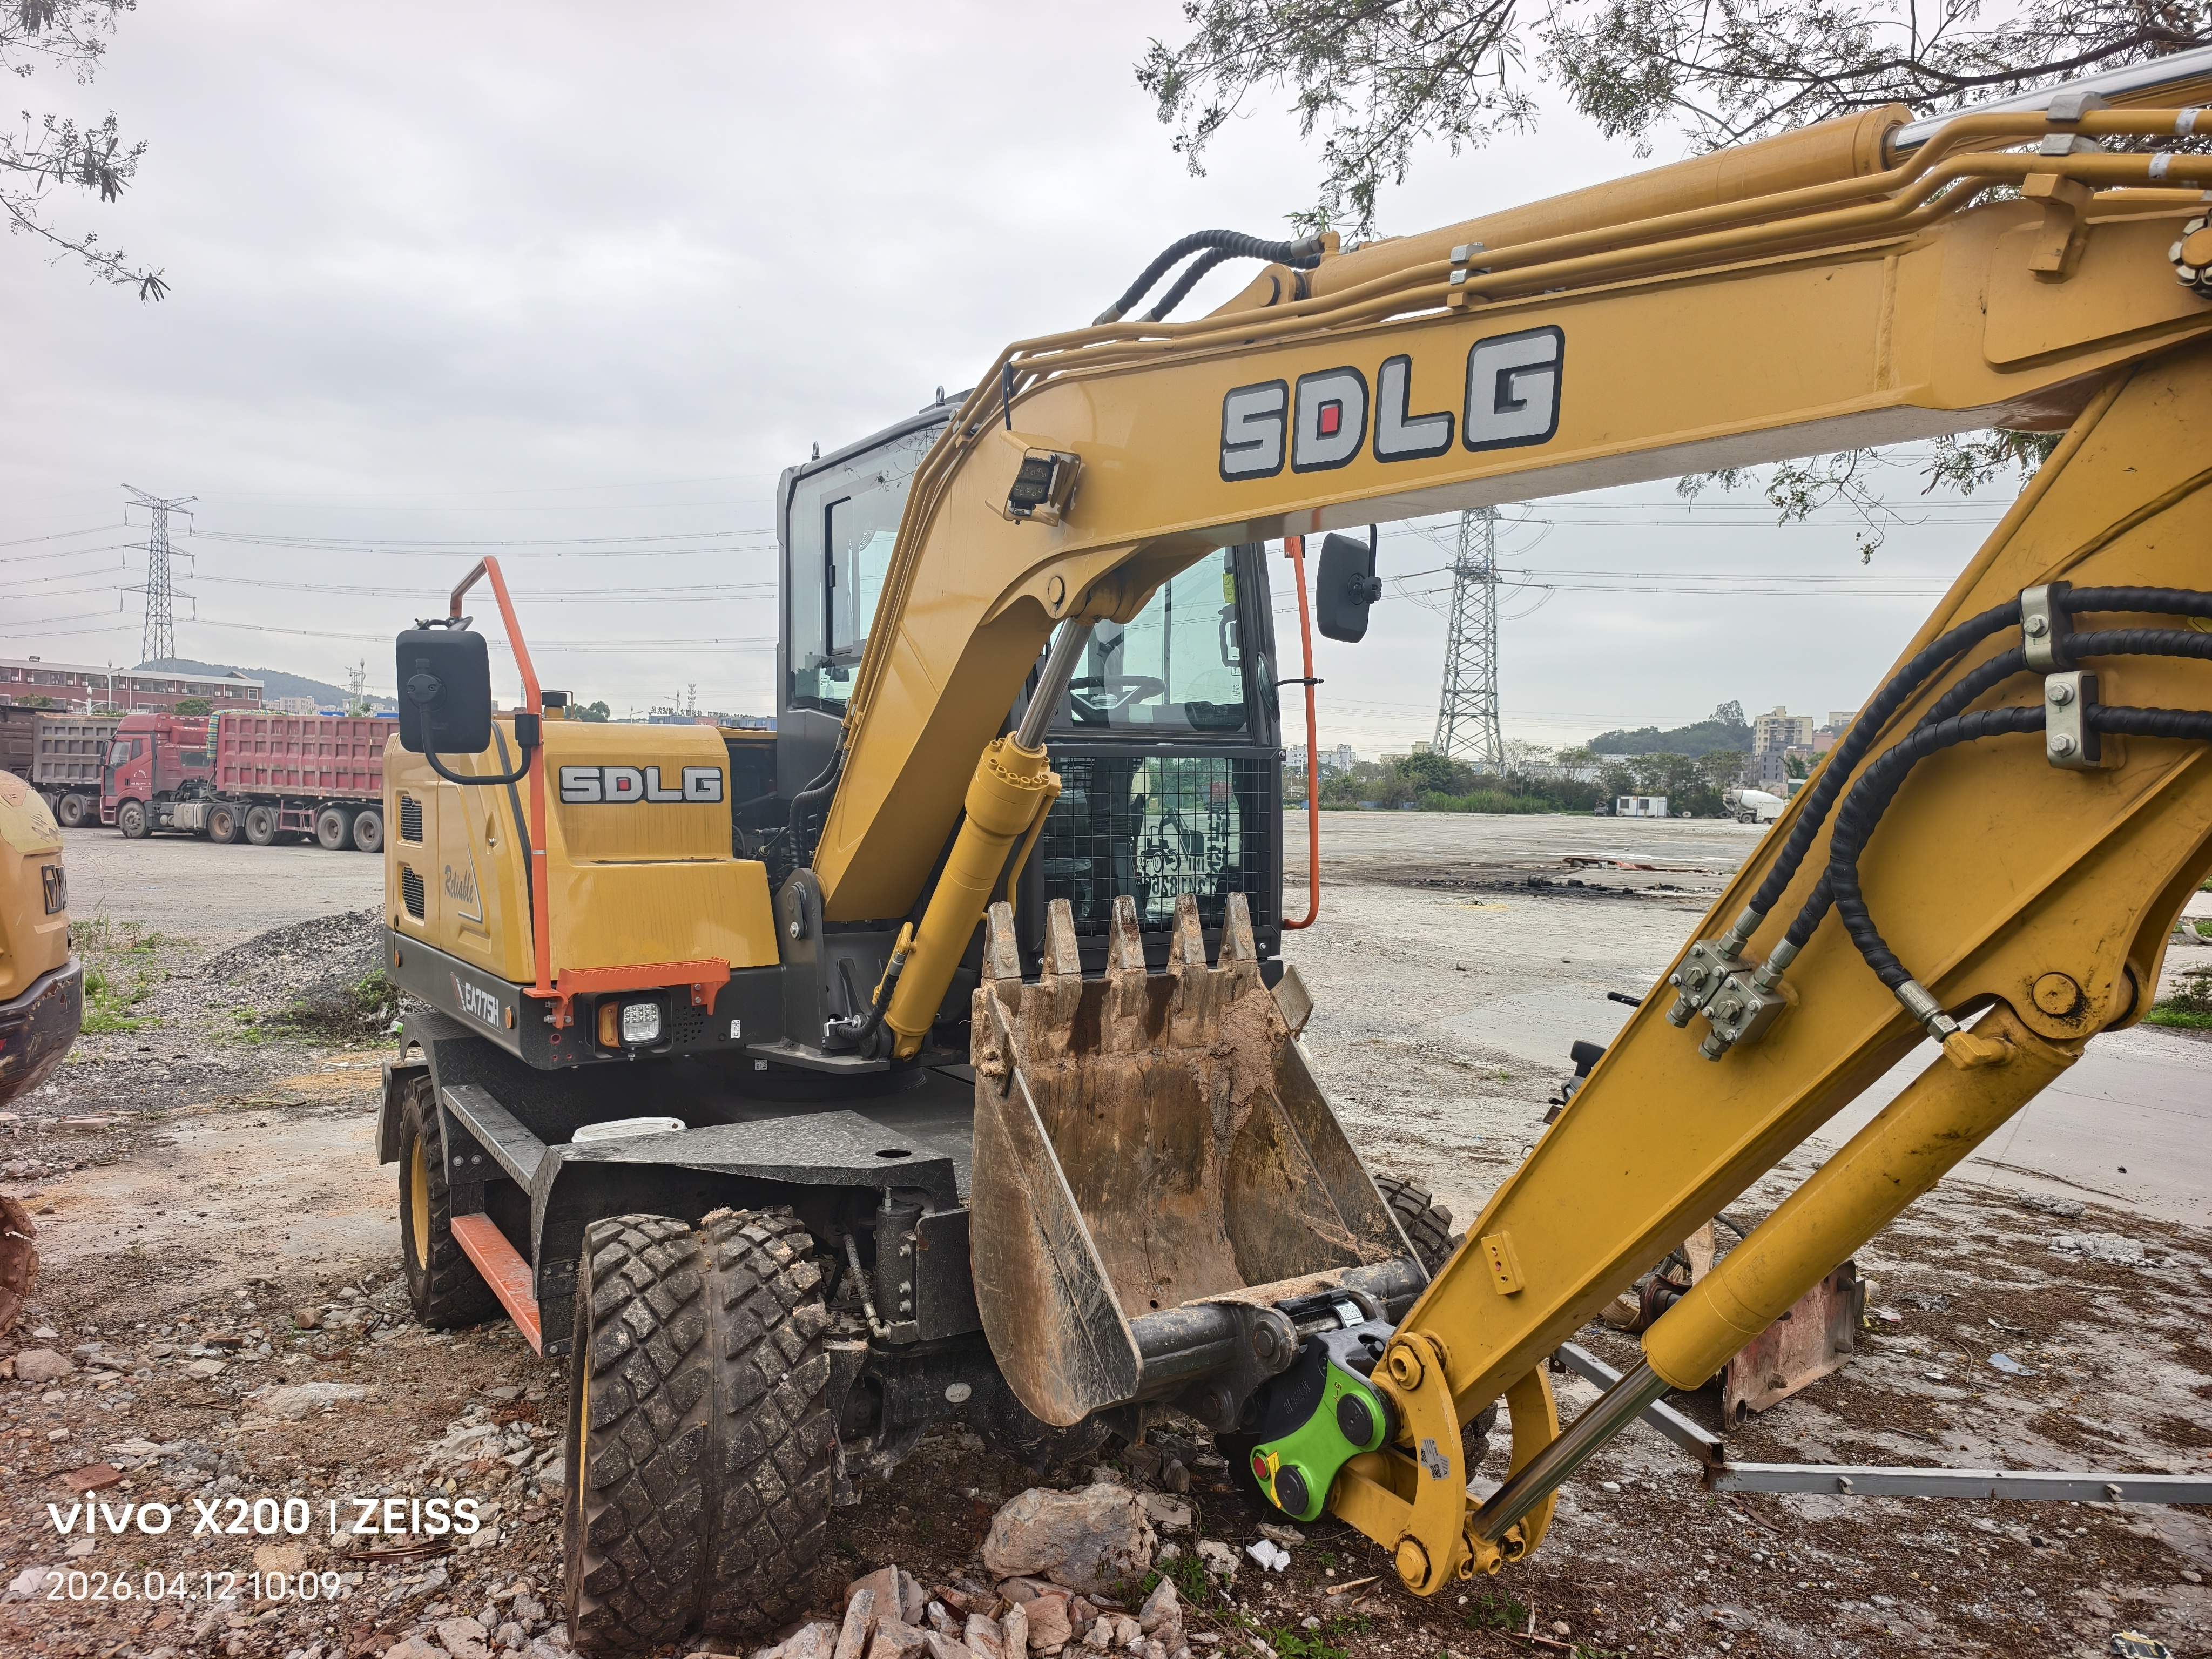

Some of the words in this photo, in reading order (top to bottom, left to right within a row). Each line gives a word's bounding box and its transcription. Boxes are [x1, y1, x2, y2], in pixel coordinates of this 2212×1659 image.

[1219, 325, 1564, 482] SDLG
[559, 766, 724, 804] SDLG
[445, 865, 474, 903] Reliable
[465, 982, 499, 1027] EA775H
